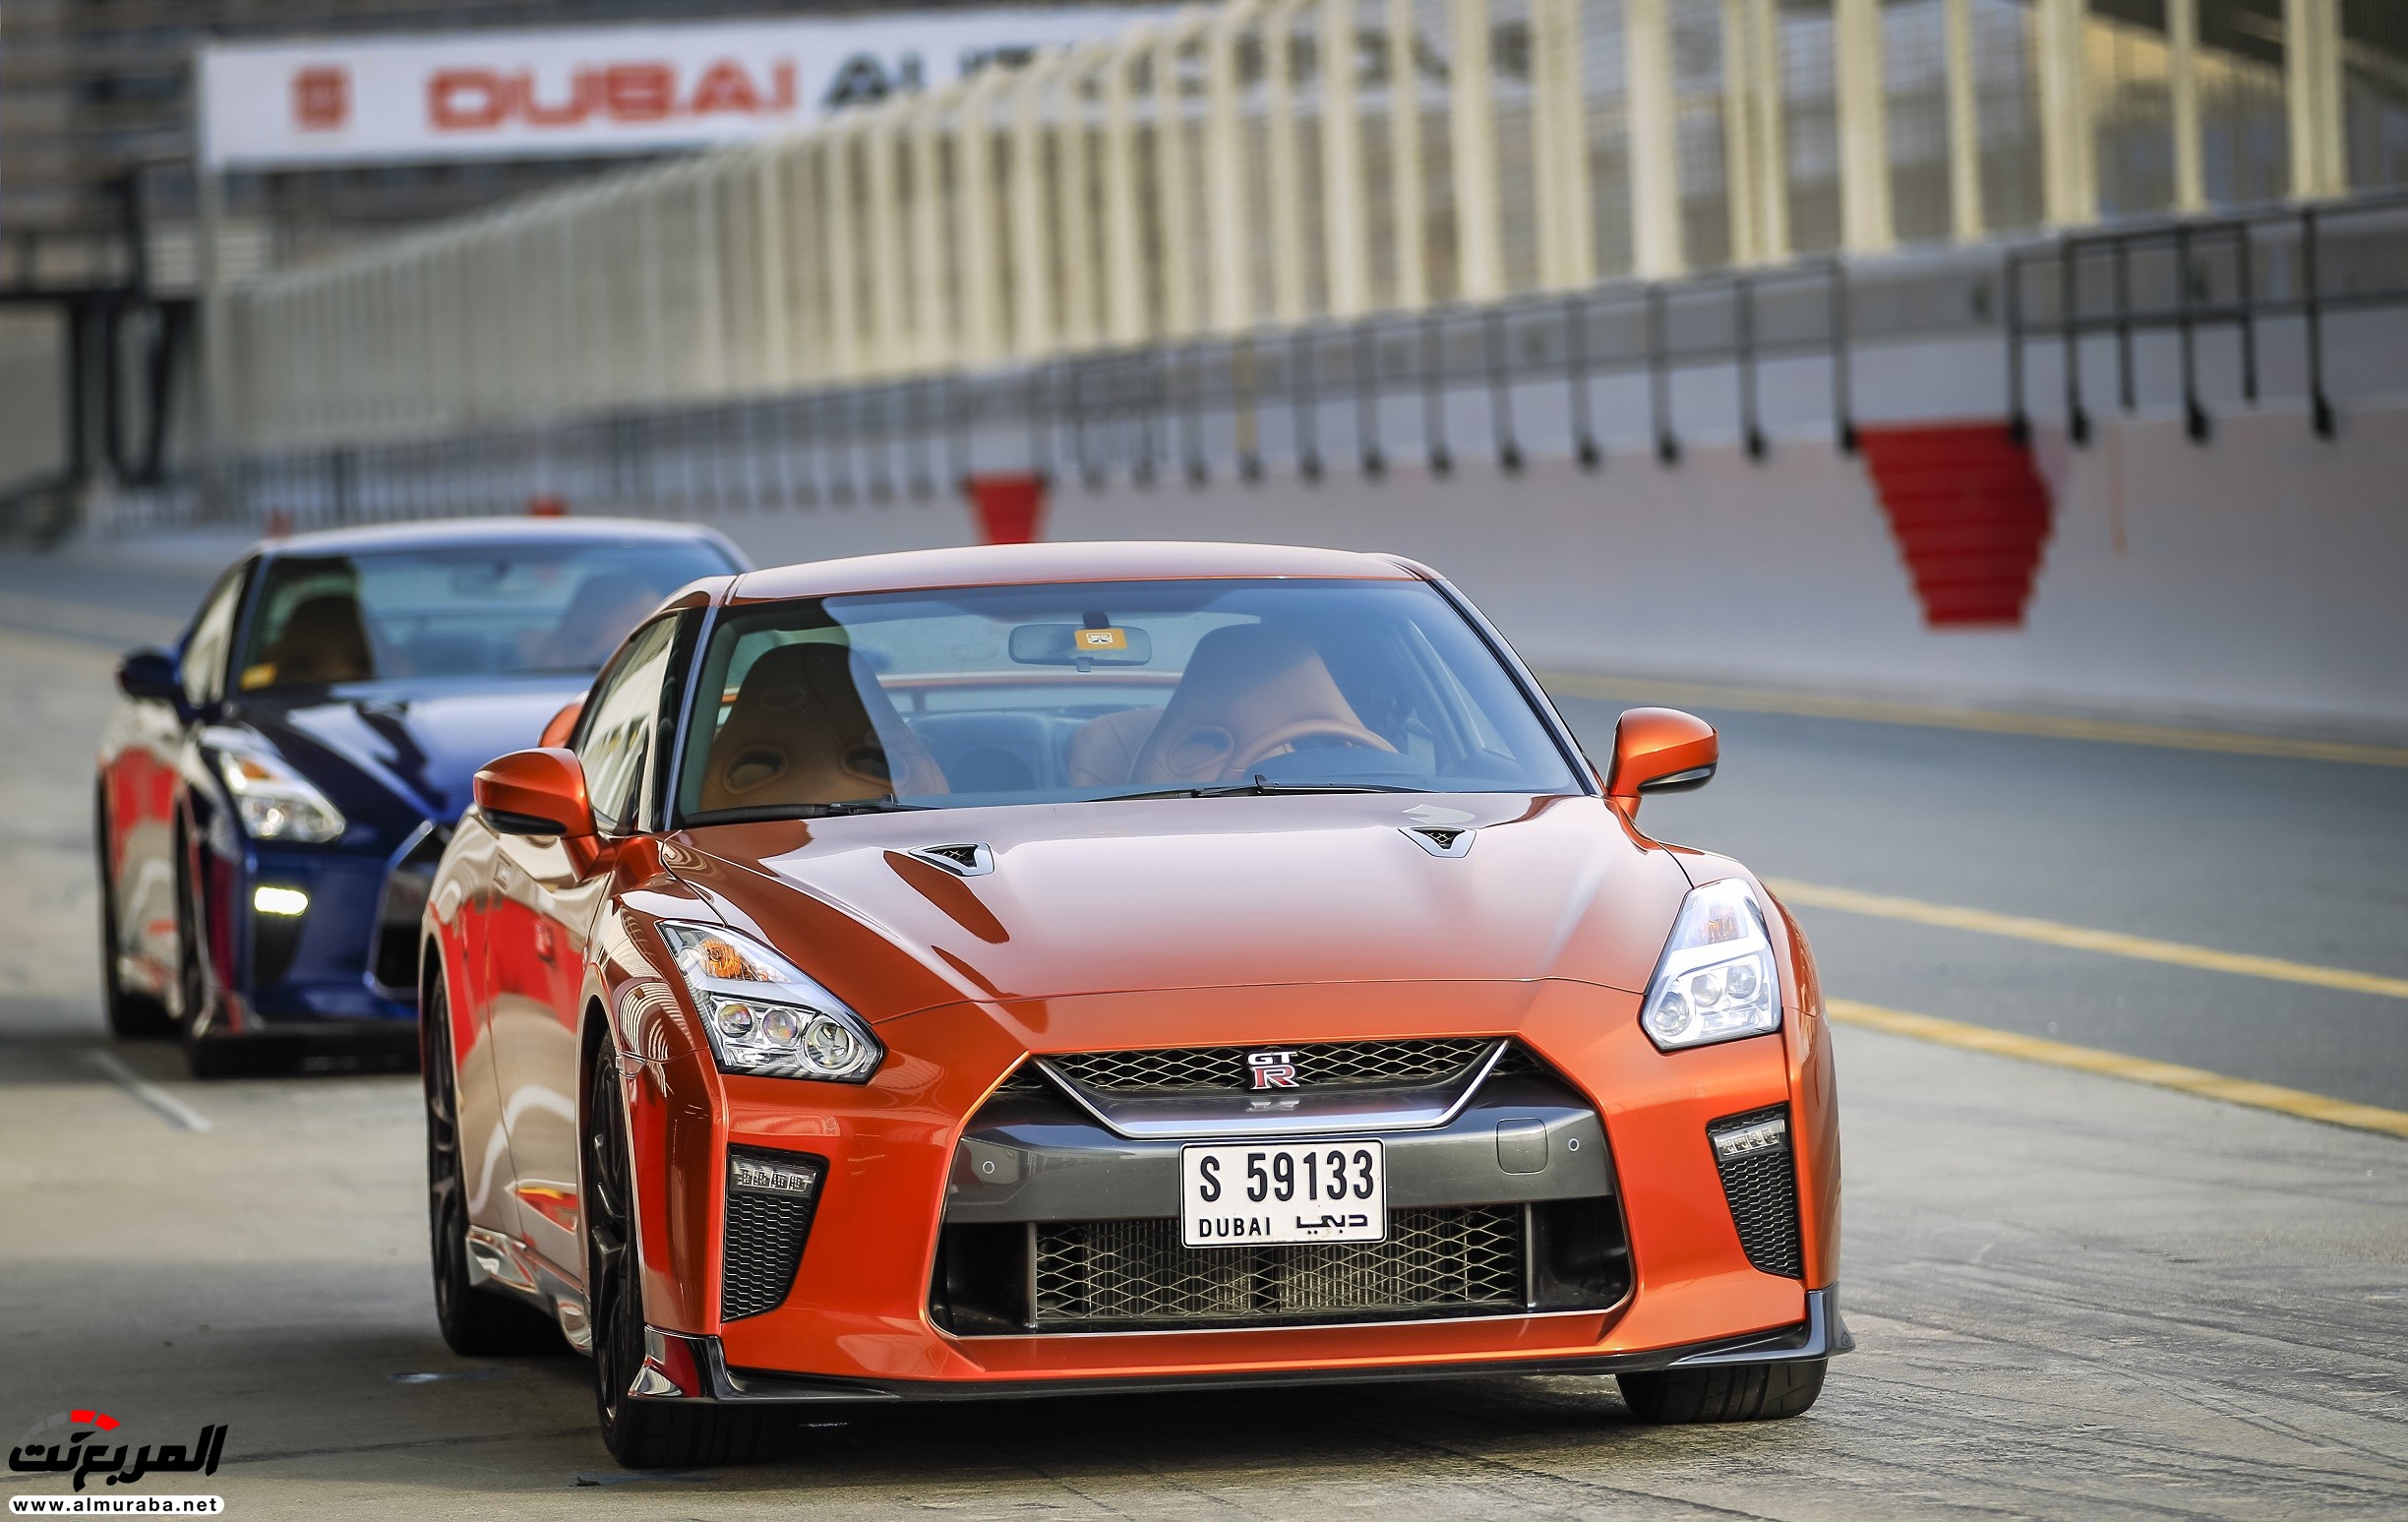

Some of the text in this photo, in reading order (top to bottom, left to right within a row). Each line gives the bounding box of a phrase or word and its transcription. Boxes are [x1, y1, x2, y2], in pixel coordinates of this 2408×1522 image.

[427, 56, 796, 130] DUBAI
[1247, 1051, 1298, 1065] GT
[1249, 1065, 1300, 1090] R
[1199, 1149, 1374, 1202] S 59133
[1199, 1217, 1271, 1238] DUBAI
[1295, 1214, 1368, 1236] دبي
